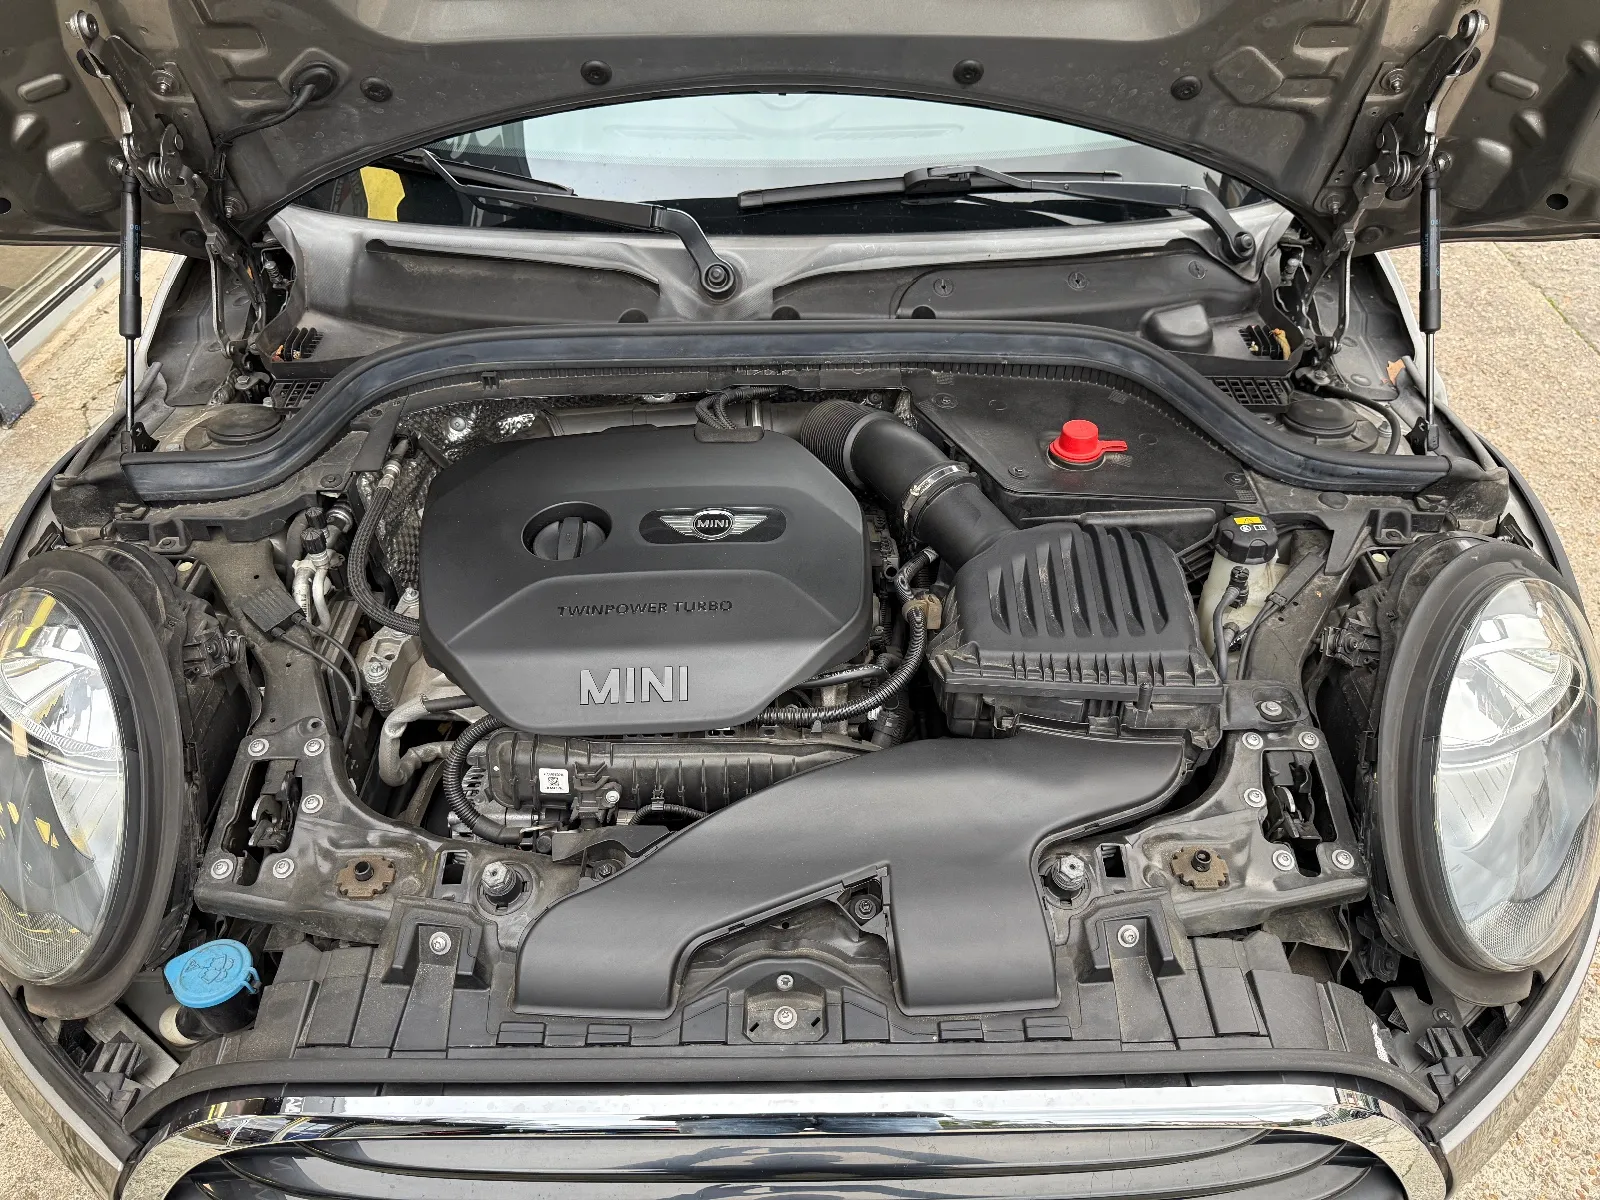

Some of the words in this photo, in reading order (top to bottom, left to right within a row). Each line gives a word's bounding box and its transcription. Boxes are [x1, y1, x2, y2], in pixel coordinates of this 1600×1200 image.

[696, 519, 730, 529] MINI
[557, 602, 668, 617] TWINPOWER
[673, 600, 733, 613] TURBO
[579, 665, 689, 706] MINI
